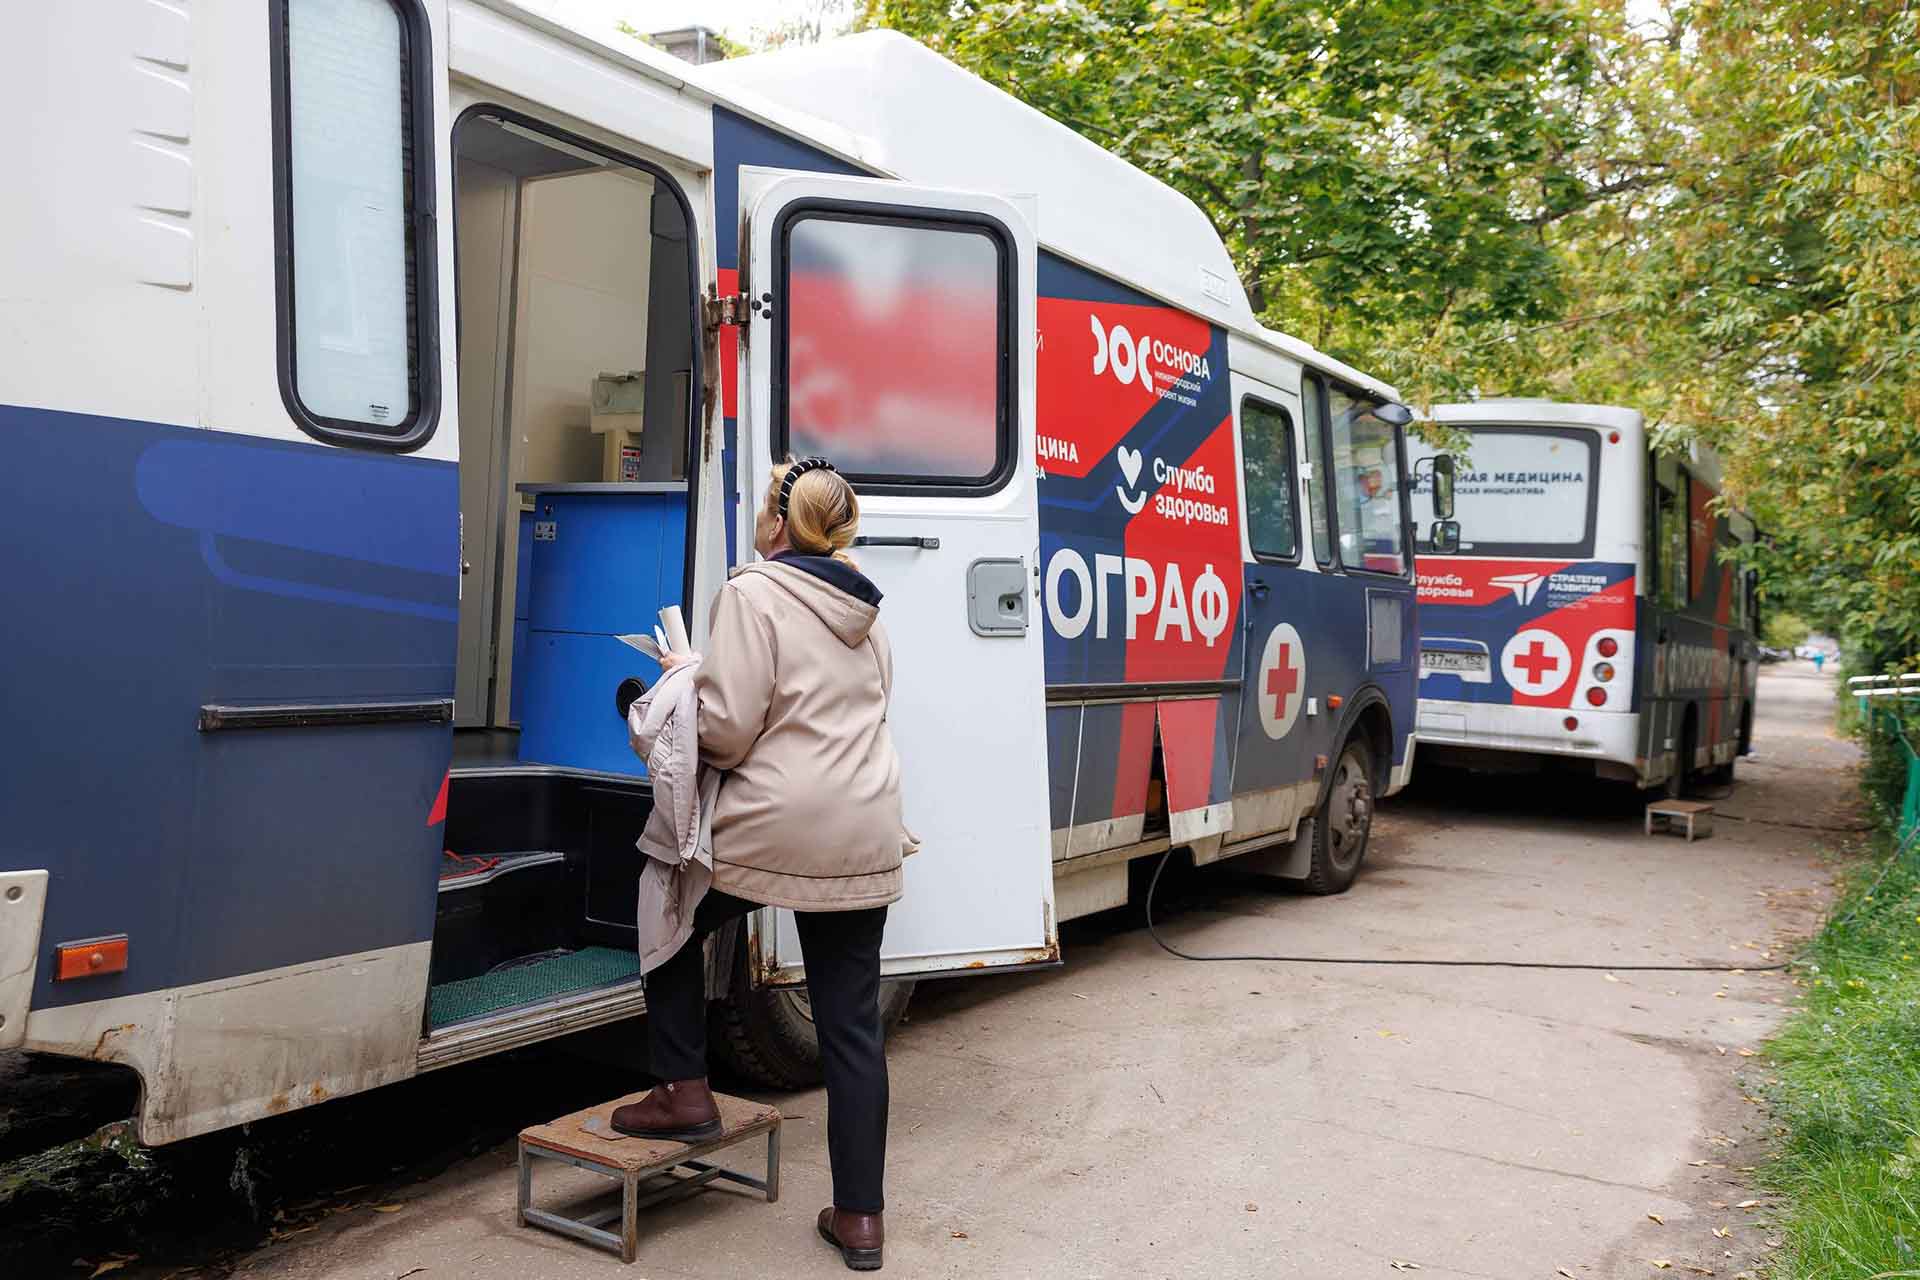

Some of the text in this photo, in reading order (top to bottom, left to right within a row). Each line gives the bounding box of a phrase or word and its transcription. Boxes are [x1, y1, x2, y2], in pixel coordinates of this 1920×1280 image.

[1153, 340, 1211, 380] ОСНОВА
[1155, 386, 1177, 400] проект
[1037, 434, 1079, 463] ЦИНА
[1153, 457, 1215, 495] Служба
[1494, 472, 1583, 484] МЕДИЦИНА
[1155, 494, 1229, 526] здоровья
[1416, 574, 1462, 586] лужба
[1416, 586, 1474, 598] доровья
[1045, 548, 1229, 647] ОГРАФ
